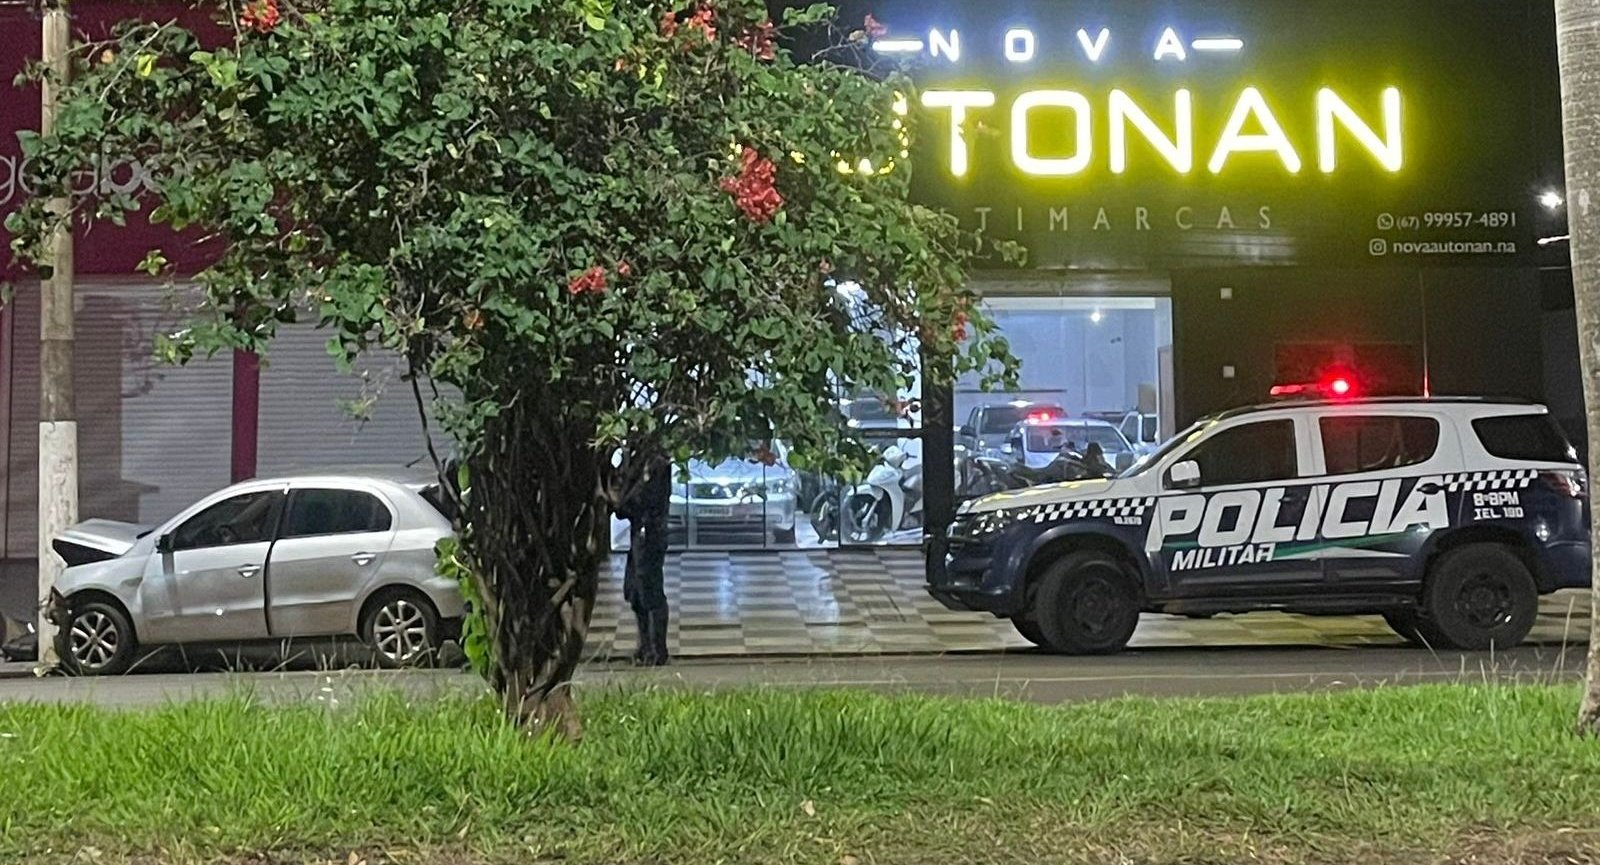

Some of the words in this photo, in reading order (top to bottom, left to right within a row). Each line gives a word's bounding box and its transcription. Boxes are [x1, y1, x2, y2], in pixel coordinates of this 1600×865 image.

[928, 27, 1186, 62] NOVA
[728, 87, 1403, 176] TONAN
[1396, 216, 1420, 229] (67)
[1423, 211, 1517, 228] 99957-4891
[1393, 241, 1516, 254] novaautonan.na
[1145, 475, 1450, 552] POLICIA
[1170, 542, 1276, 572] MILITAR
